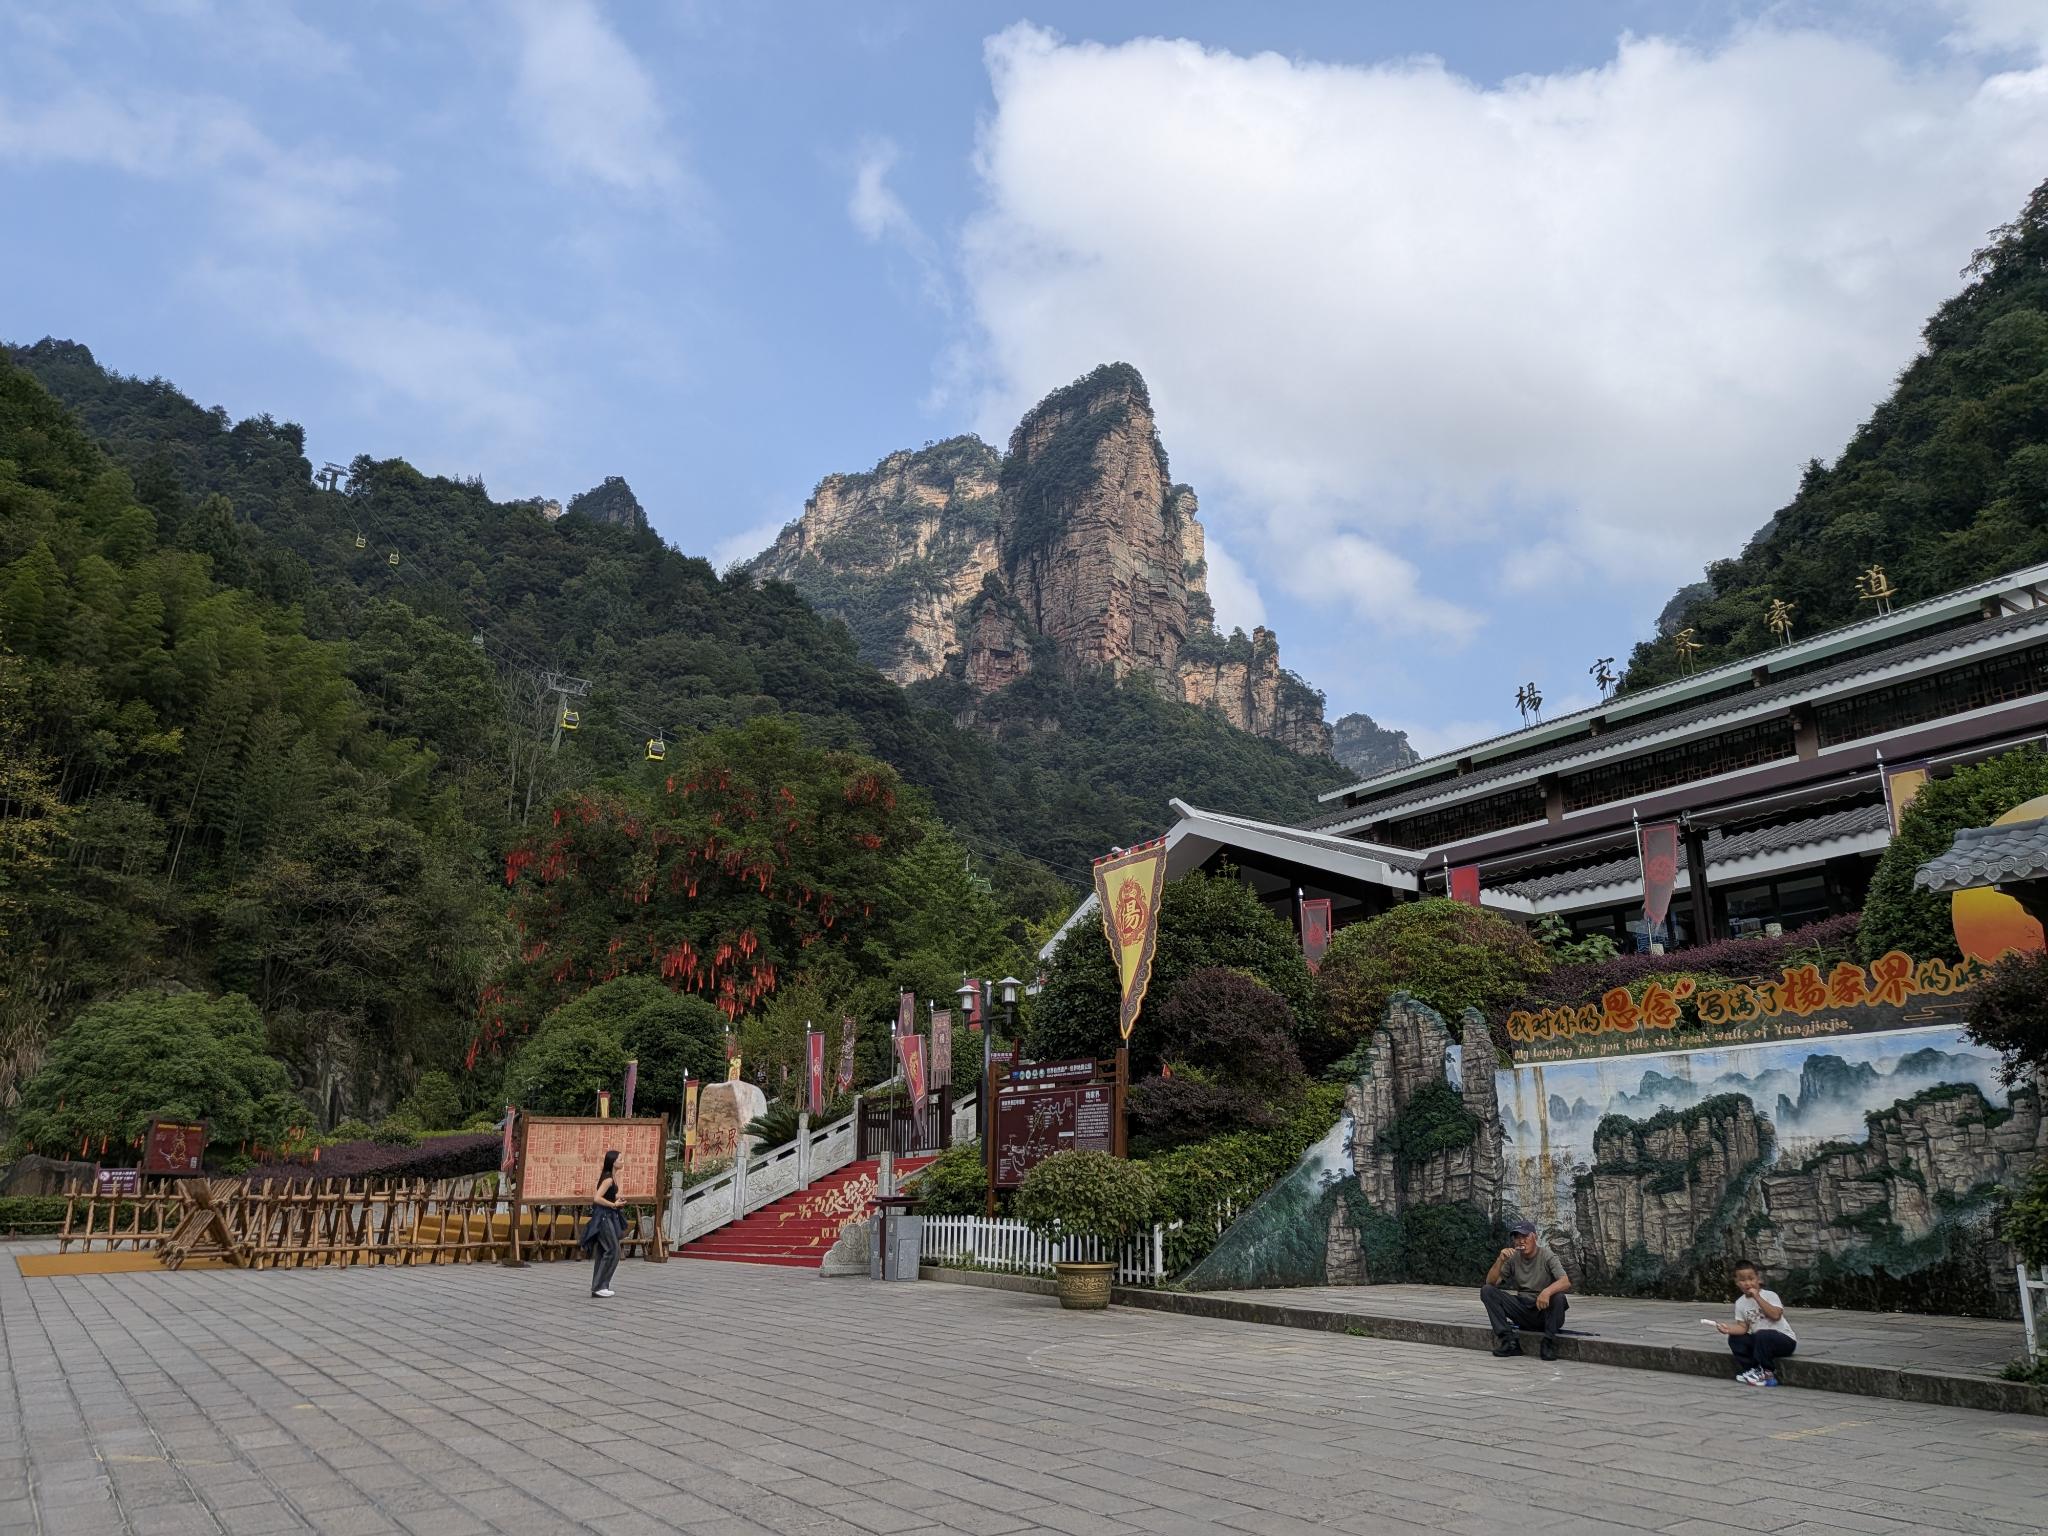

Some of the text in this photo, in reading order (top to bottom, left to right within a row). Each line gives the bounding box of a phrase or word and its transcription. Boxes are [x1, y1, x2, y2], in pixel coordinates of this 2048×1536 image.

[1699, 951, 1986, 1022] 写满了楊家界的峰
[1514, 1049, 1529, 1061] My
[1579, 1043, 1596, 1055] for
[1600, 1042, 1620, 1055] you
[1714, 1028, 1749, 1042] walls
[1753, 1024, 1769, 1039] of
